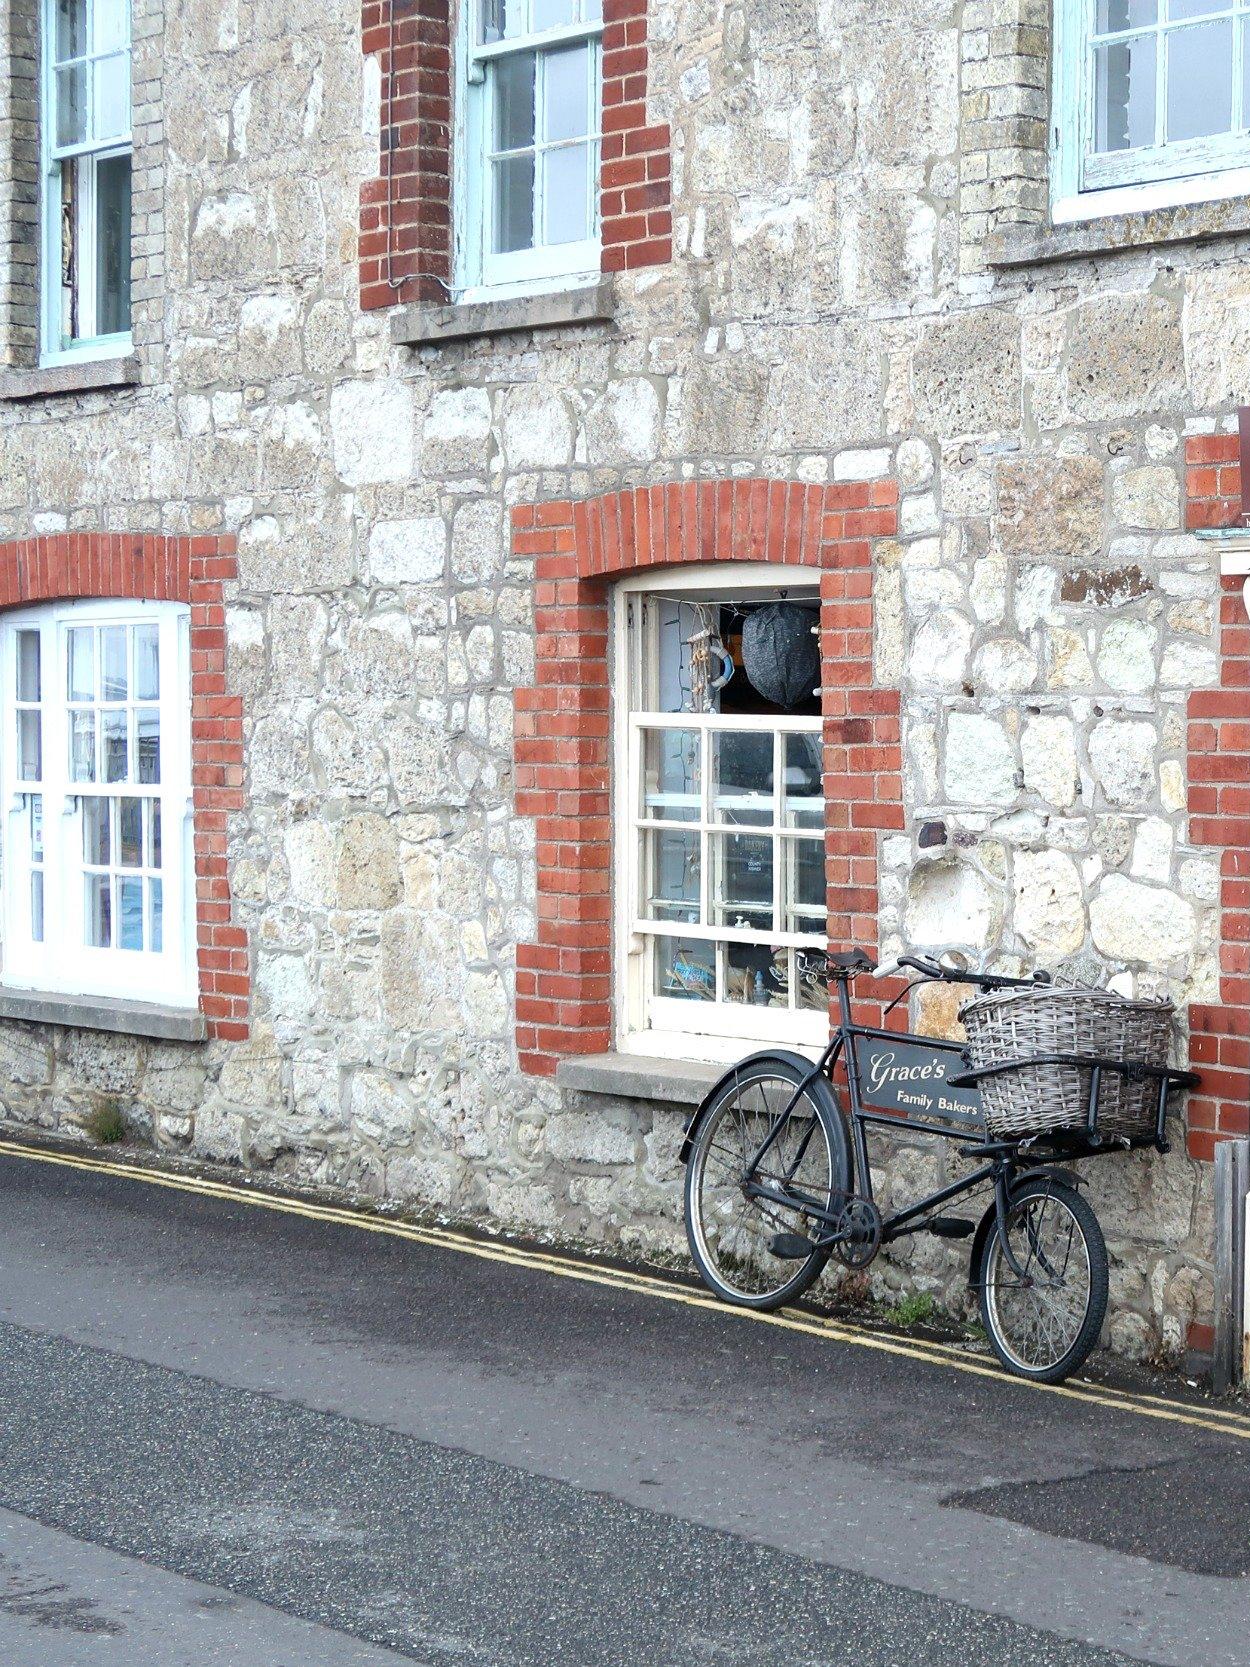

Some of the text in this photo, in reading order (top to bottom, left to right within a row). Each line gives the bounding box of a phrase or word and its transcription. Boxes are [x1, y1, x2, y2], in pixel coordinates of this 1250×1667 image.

[867, 1053, 946, 1093] Grace's
[897, 1091, 978, 1115] Family Bakers
